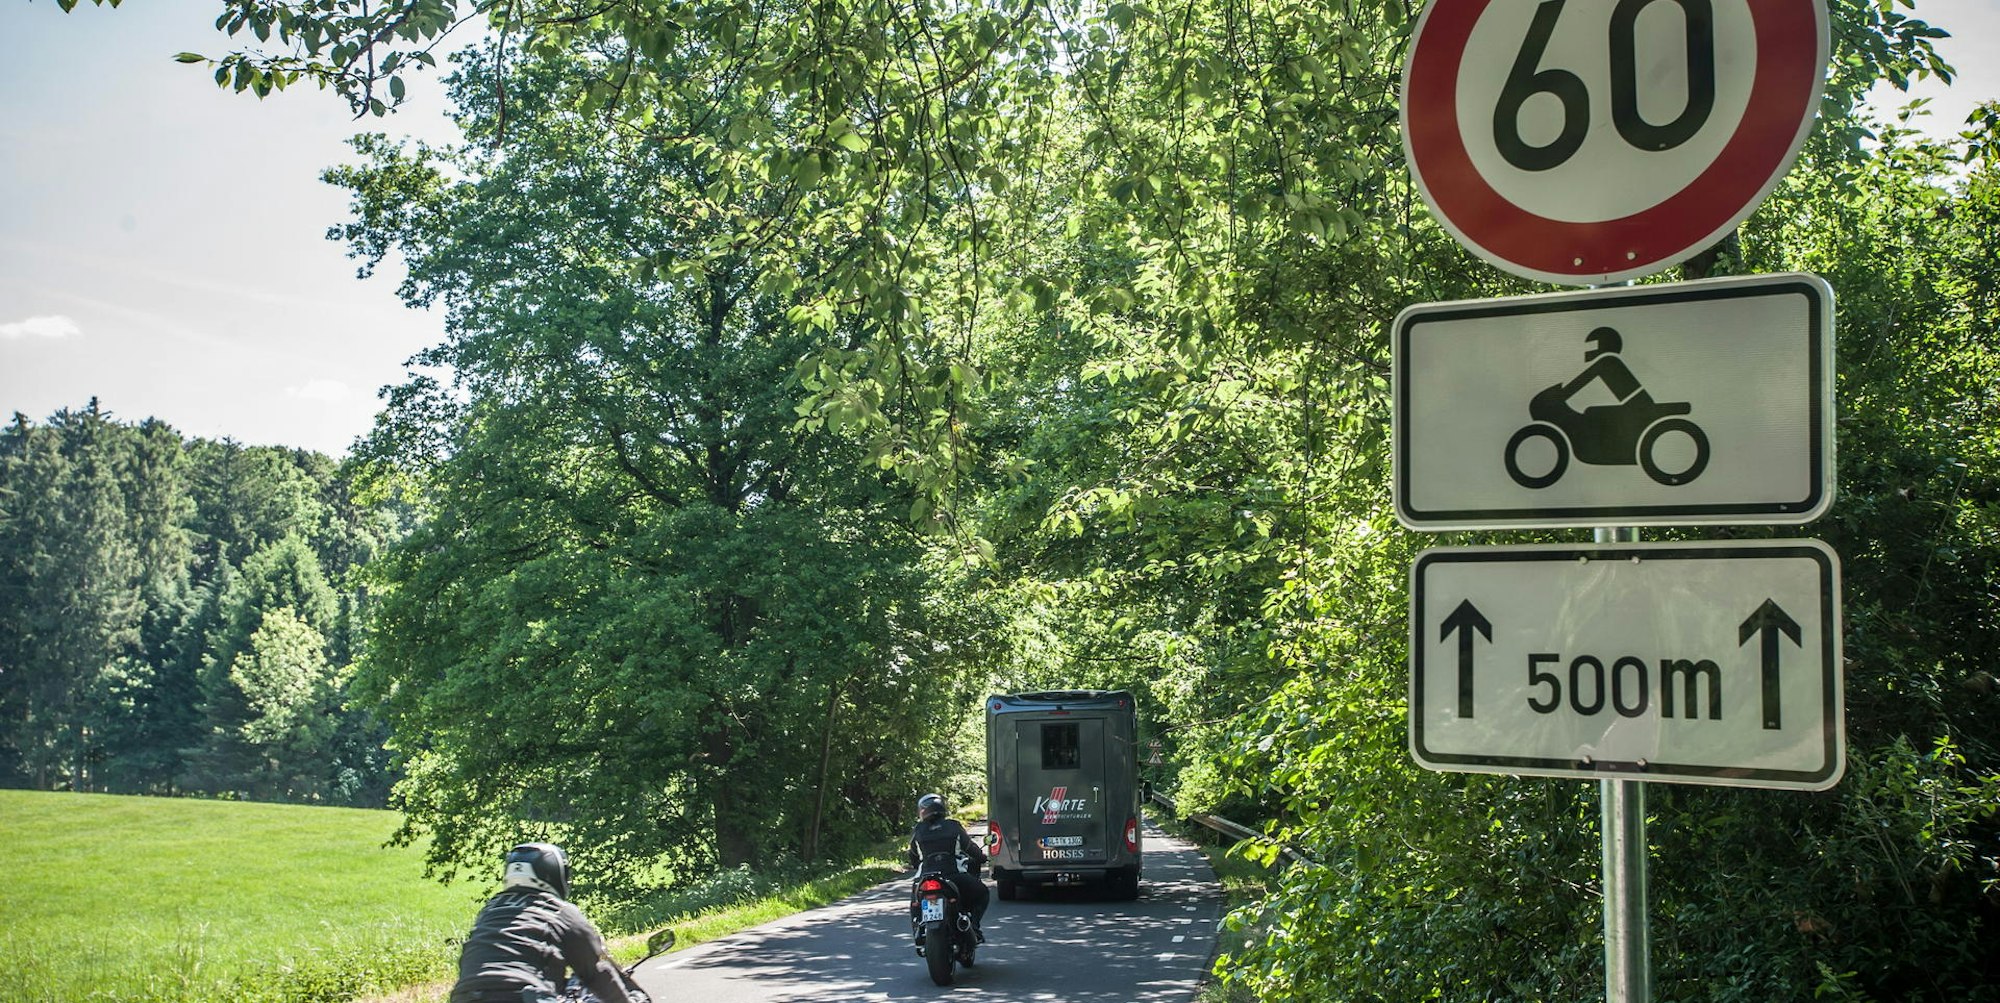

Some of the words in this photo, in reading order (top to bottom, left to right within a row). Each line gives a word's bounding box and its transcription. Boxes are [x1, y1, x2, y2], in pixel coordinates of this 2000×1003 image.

[1493, 0, 1715, 171] 60
[1033, 796, 1086, 814] KORTE
[1043, 850, 1084, 859] HORSES
